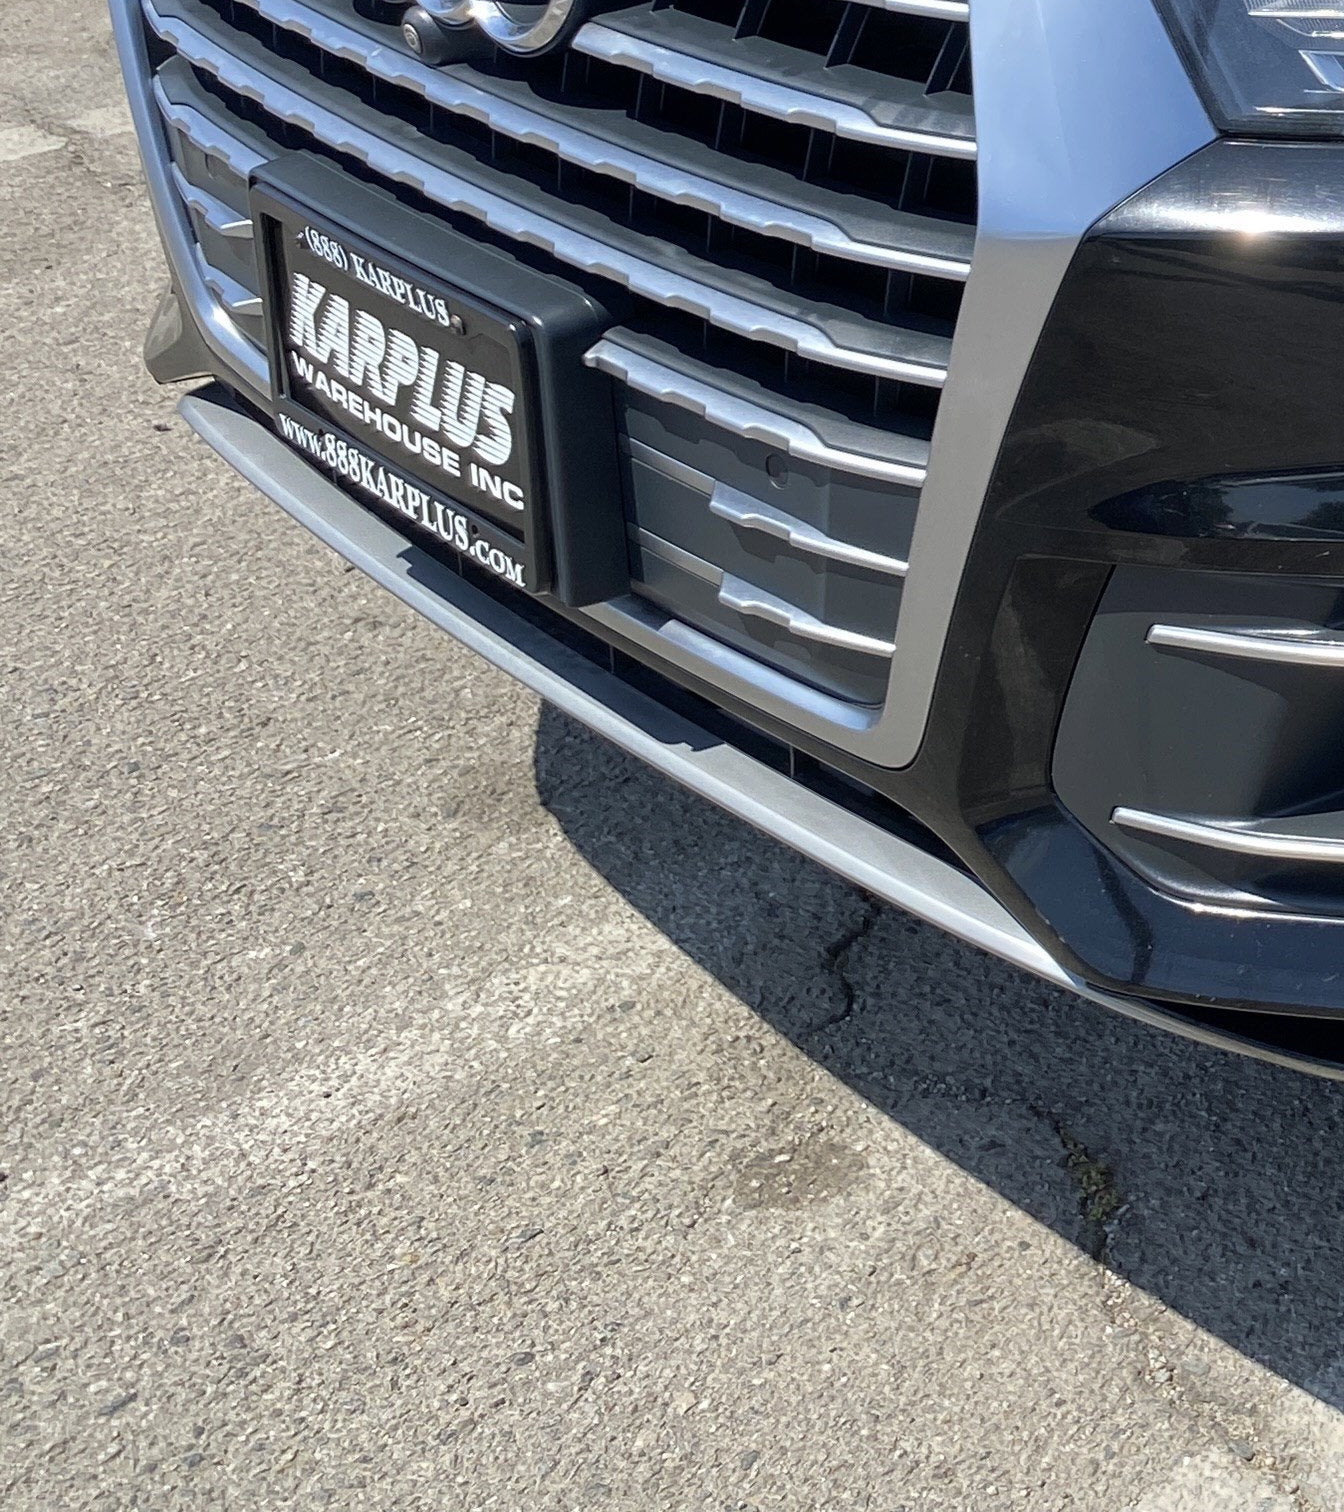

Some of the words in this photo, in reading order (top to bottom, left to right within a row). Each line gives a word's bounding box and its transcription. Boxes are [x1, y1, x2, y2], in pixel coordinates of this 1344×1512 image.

[304, 225, 349, 272] (888)
[349, 252, 451, 328] KARPLUS
[290, 272, 516, 466] KARPLUS
[291, 350, 462, 478] WAREHOUSE
[469, 462, 525, 511] INC
